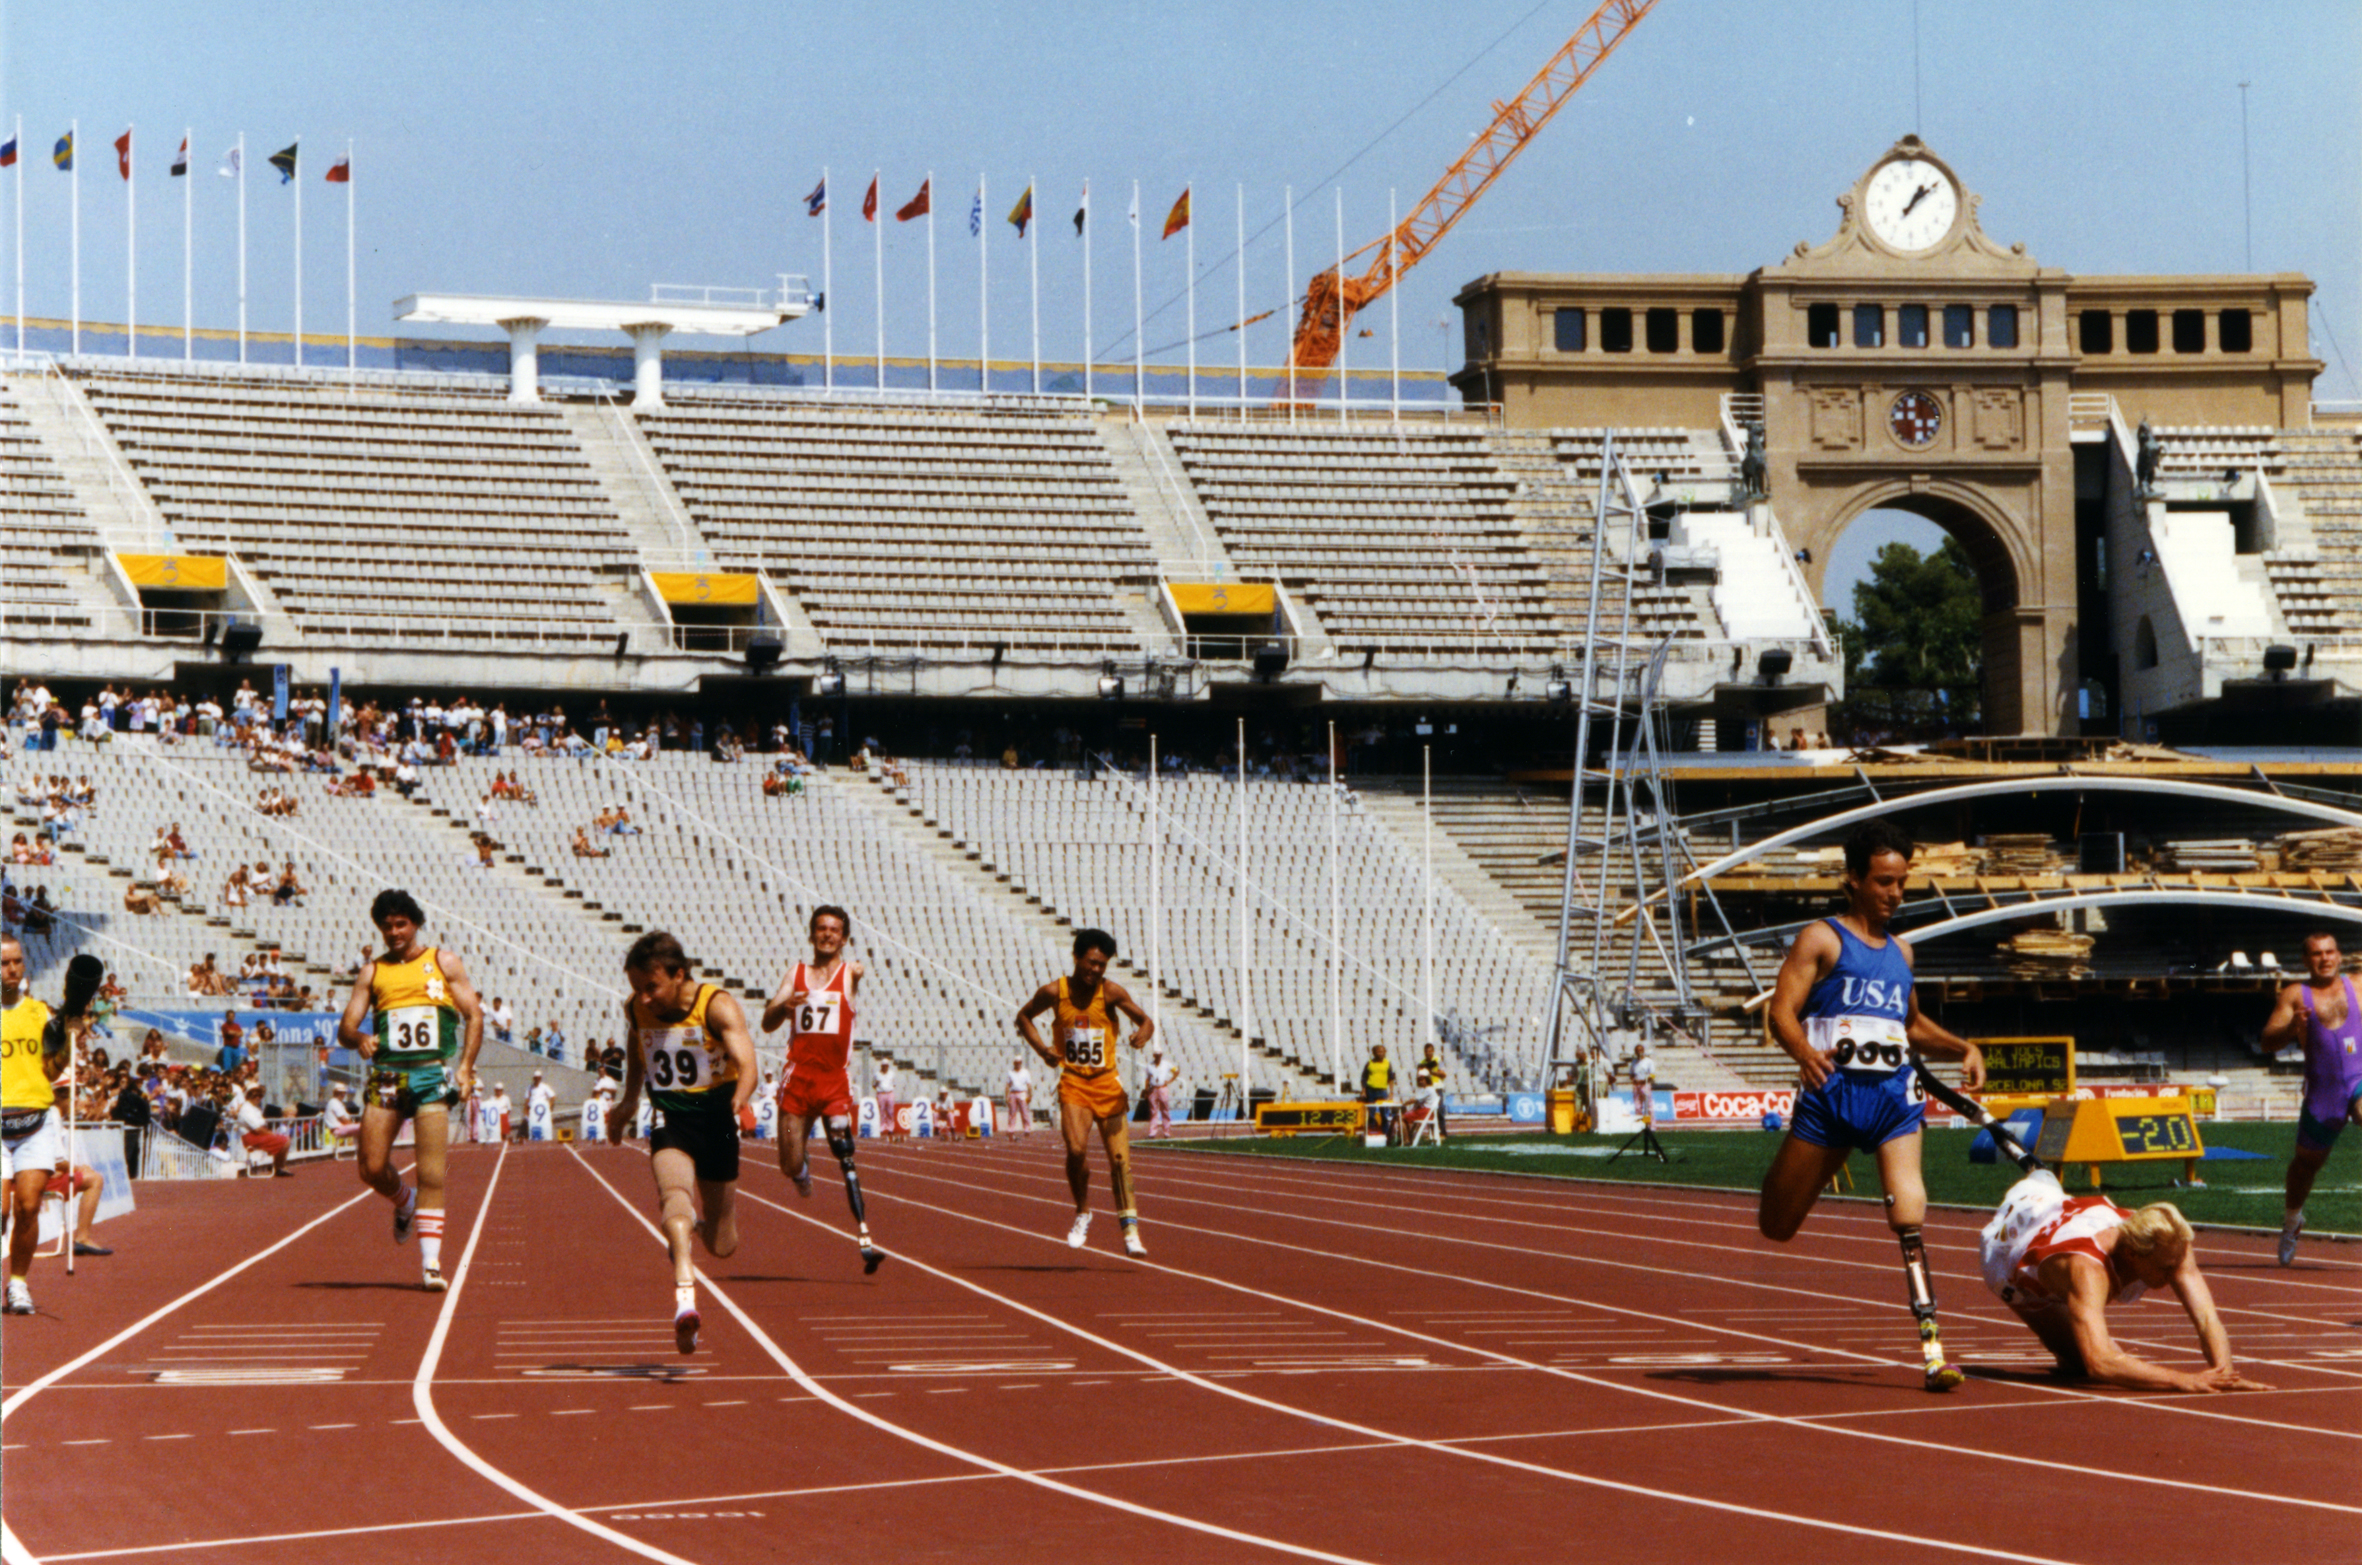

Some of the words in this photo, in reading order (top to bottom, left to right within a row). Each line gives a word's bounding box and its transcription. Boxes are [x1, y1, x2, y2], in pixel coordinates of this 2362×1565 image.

[1842, 976, 1904, 1014] USA
[801, 1005, 830, 1031] 67
[211, 1018, 341, 1047] Brlona'9
[398, 1022, 430, 1049] 36
[1065, 1040, 1102, 1065] 655
[653, 1049, 698, 1087] 39
[1983, 1079, 2045, 1092] ARCELONA
[534, 1104, 546, 1122] 9
[587, 1103, 599, 1122] 8
[761, 1102, 773, 1121] 5
[863, 1102, 875, 1120] 3
[916, 1101, 927, 1119] 2
[978, 1101, 985, 1118] 1
[1703, 1091, 1797, 1117] Coca-Co
[481, 1107, 499, 1126] 10
[2122, 1116, 2191, 1151] -2.0
